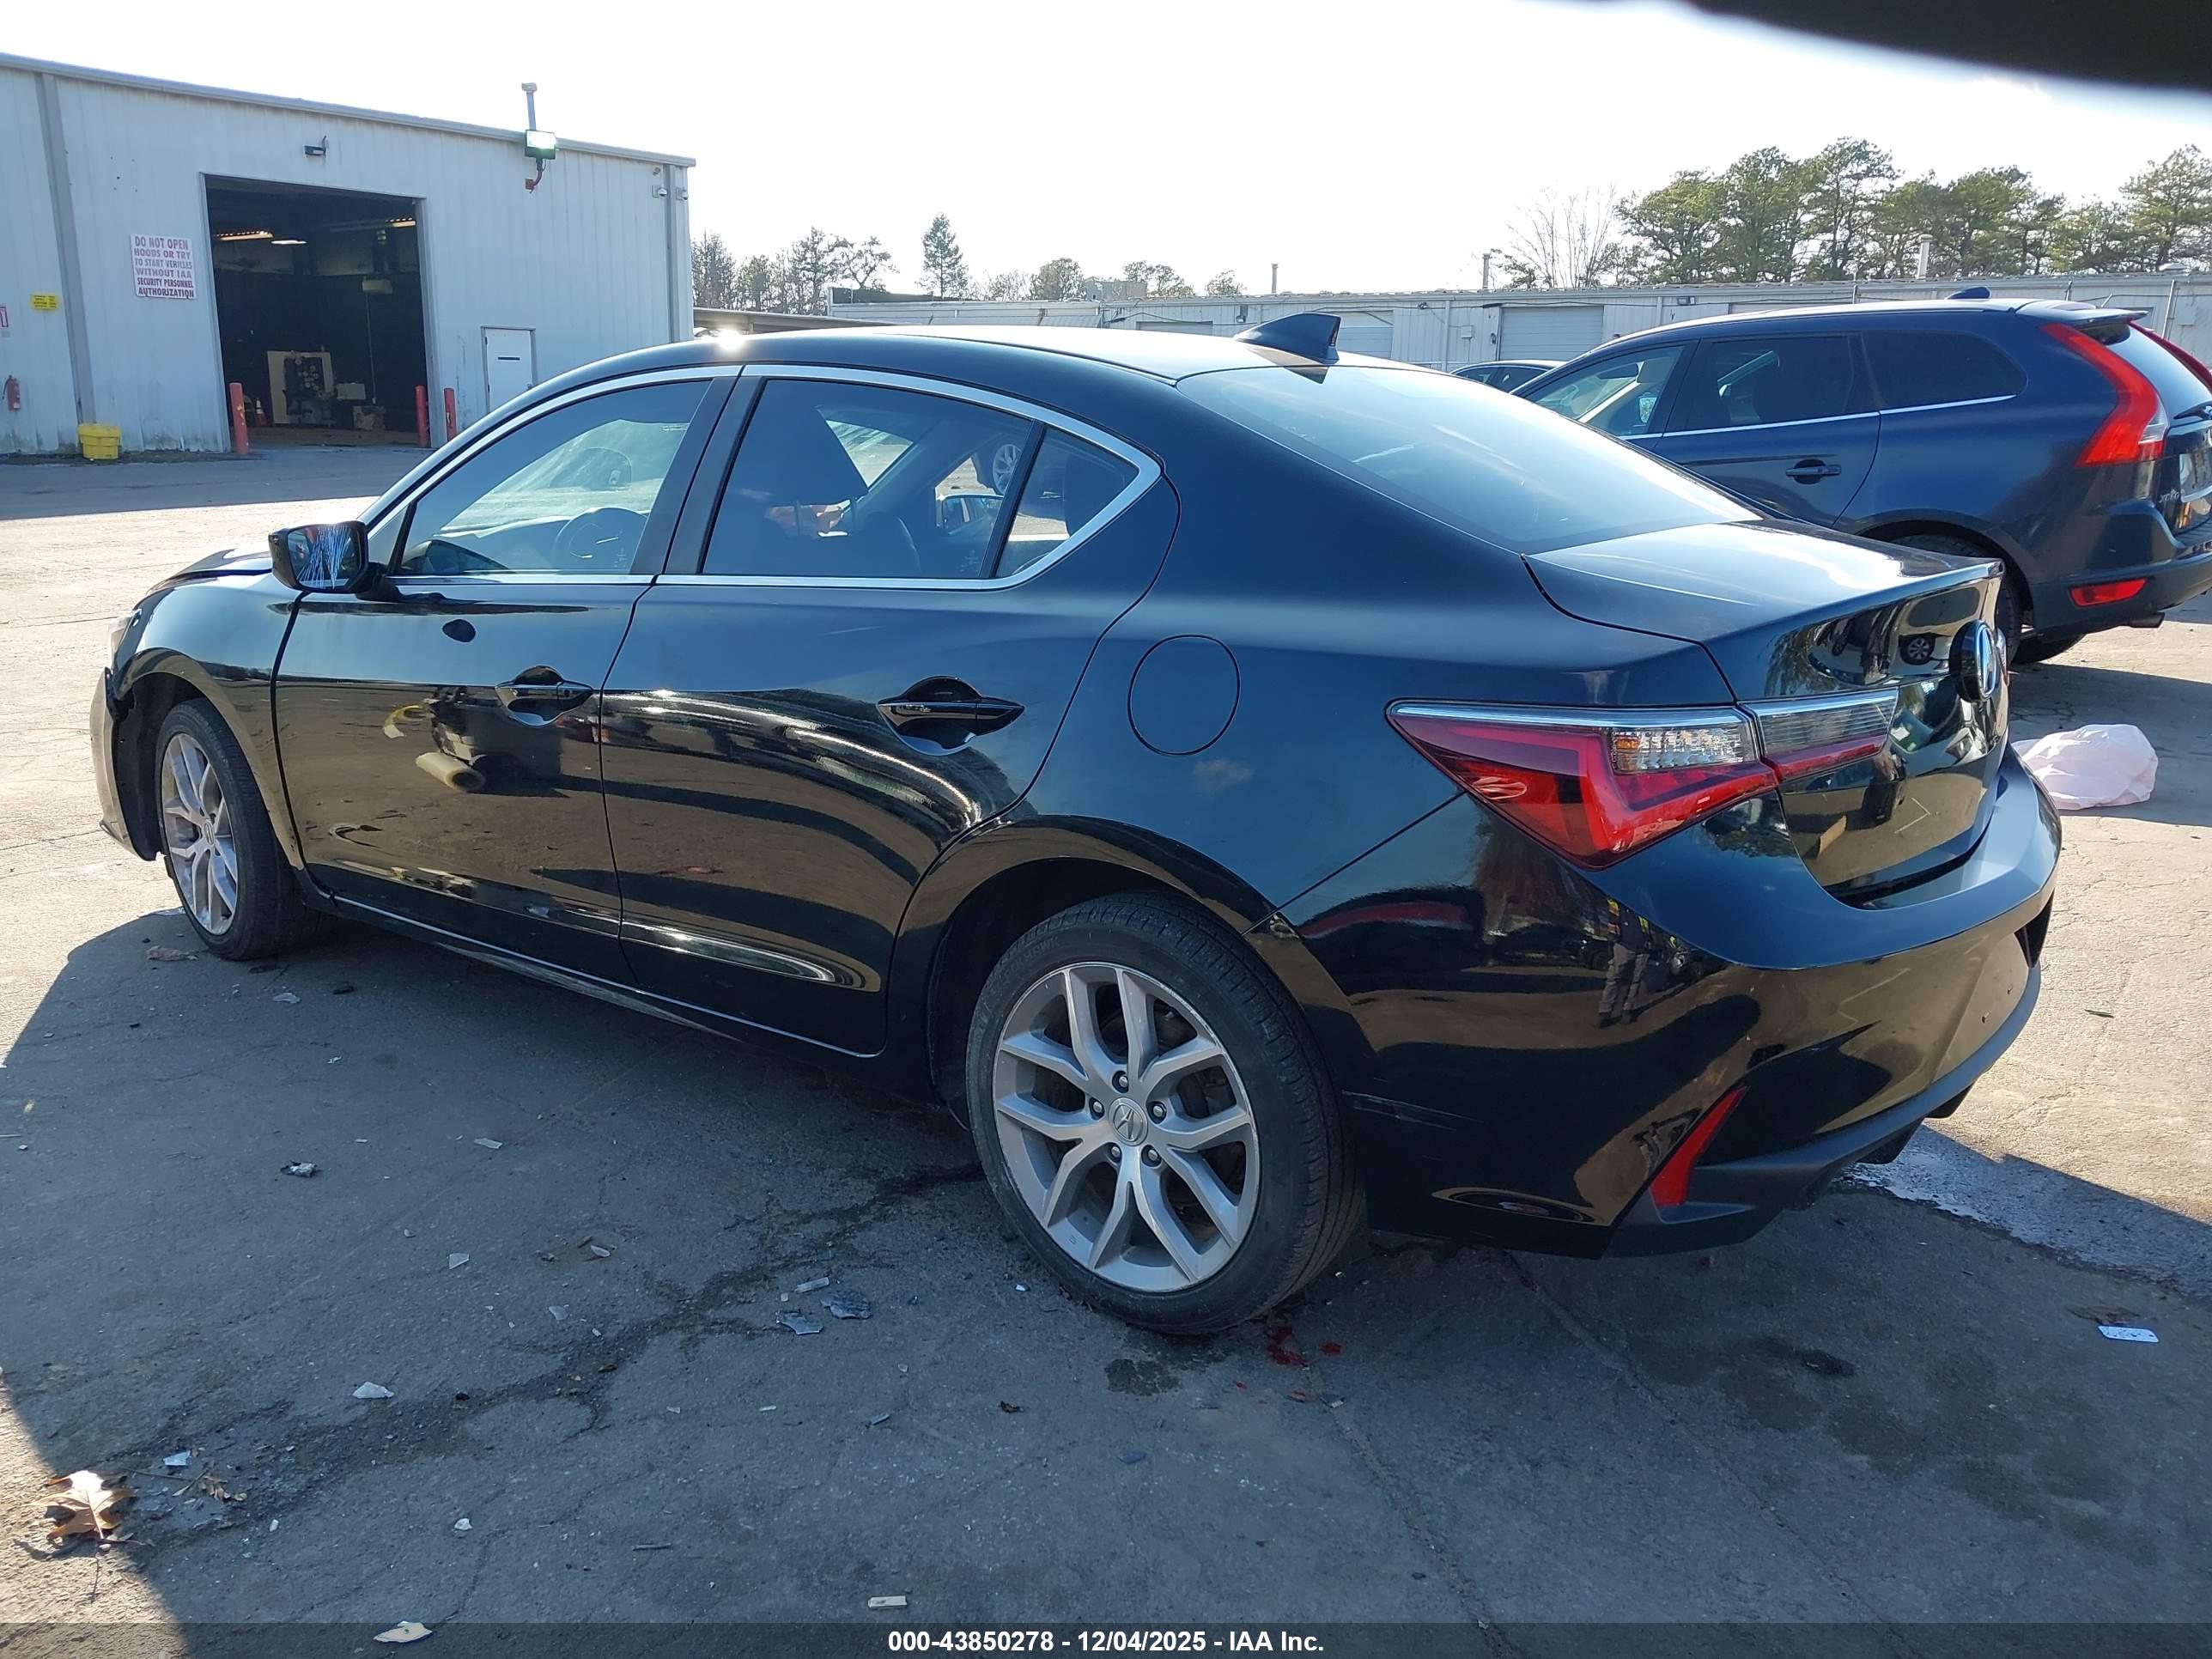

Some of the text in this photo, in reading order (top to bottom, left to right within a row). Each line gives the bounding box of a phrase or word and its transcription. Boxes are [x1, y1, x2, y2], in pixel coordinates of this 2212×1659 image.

[135, 236, 188, 250] DO NOT OPEN
[134, 247, 191, 259] HOODS OR TRY
[134, 258, 192, 270] TO START VEHICLES
[136, 267, 191, 278] WITHOUT IAA
[137, 276, 193, 289] SECURITY PERSONNEL
[138, 287, 194, 298] AUTHORIZATION
